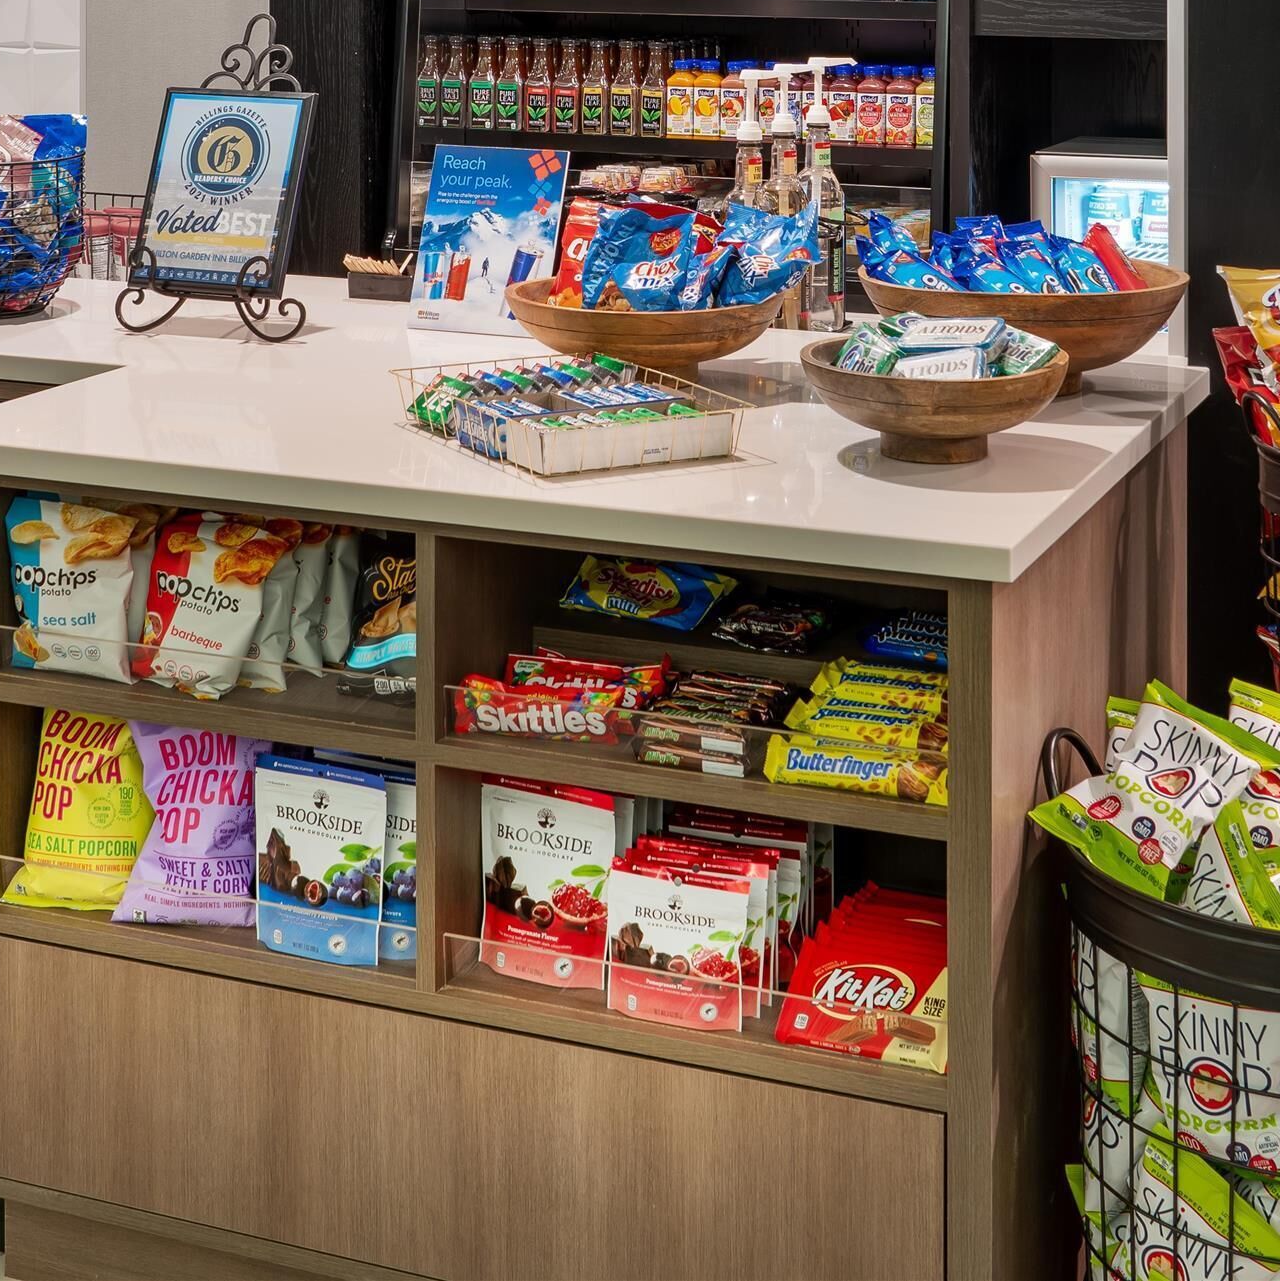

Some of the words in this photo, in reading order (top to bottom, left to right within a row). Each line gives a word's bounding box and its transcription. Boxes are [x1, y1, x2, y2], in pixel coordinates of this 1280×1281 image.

[194, 104, 234, 128] BILLINGS
[236, 104, 268, 131] GAZETTE
[443, 154, 487, 171] Reach
[193, 174, 224, 184] READERS'
[224, 175, 248, 185] CHOICE
[440, 175, 472, 188] your
[474, 174, 513, 190] peak.
[183, 181, 207, 204] 2021
[209, 186, 254, 207] WINNER
[155, 204, 224, 235] Voted
[220, 210, 272, 237] BEST
[179, 252, 212, 262] GARDEN
[212, 254, 228, 263] INN
[634, 255, 679, 278] Chex
[638, 272, 680, 291] mix
[917, 323, 989, 337] ALTOIDS
[838, 344, 878, 375] Orbit
[15, 562, 97, 593] popchips
[598, 567, 676, 600] Swedish
[40, 587, 72, 598] potato
[156, 569, 242, 614] popchips
[180, 599, 214, 616] potato
[606, 595, 641, 616] mini
[42, 614, 68, 626] sea
[70, 612, 97, 627] salt
[169, 624, 223, 652] barbeque
[375, 679, 389, 690] 200
[44, 708, 125, 752] BOOM
[476, 703, 607, 736] Skittles
[37, 740, 123, 785] CHICKA
[158, 730, 237, 771] BOOM
[786, 747, 894, 780] Butterfinger
[32, 779, 74, 821] POP
[119, 786, 134, 799] 190
[156, 769, 254, 807] CHICKA
[1105, 769, 1194, 840] POPCORN
[276, 805, 364, 836] BROOKSIDE
[27, 833, 42, 848] SEA
[44, 837, 74, 854] SALT
[78, 839, 137, 857] POPCORN
[307, 829, 346, 842] CHOCOLATE
[496, 823, 593, 856] BROOKSIDE
[1250, 830, 1270, 847] GMO
[1139, 844, 1160, 864] FREE
[158, 855, 201, 878] SWEET
[216, 857, 252, 877] SALTY
[213, 875, 251, 894] CORN
[634, 904, 717, 929] BROOKSIDE
[540, 931, 560, 943] Flavor
[922, 1006, 944, 1019] SIZE
[923, 996, 947, 1009] KING
[1156, 1003, 1268, 1061] SKINNY
[1159, 1044, 1273, 1117] POP
[1164, 1102, 1279, 1135] POPCORN
